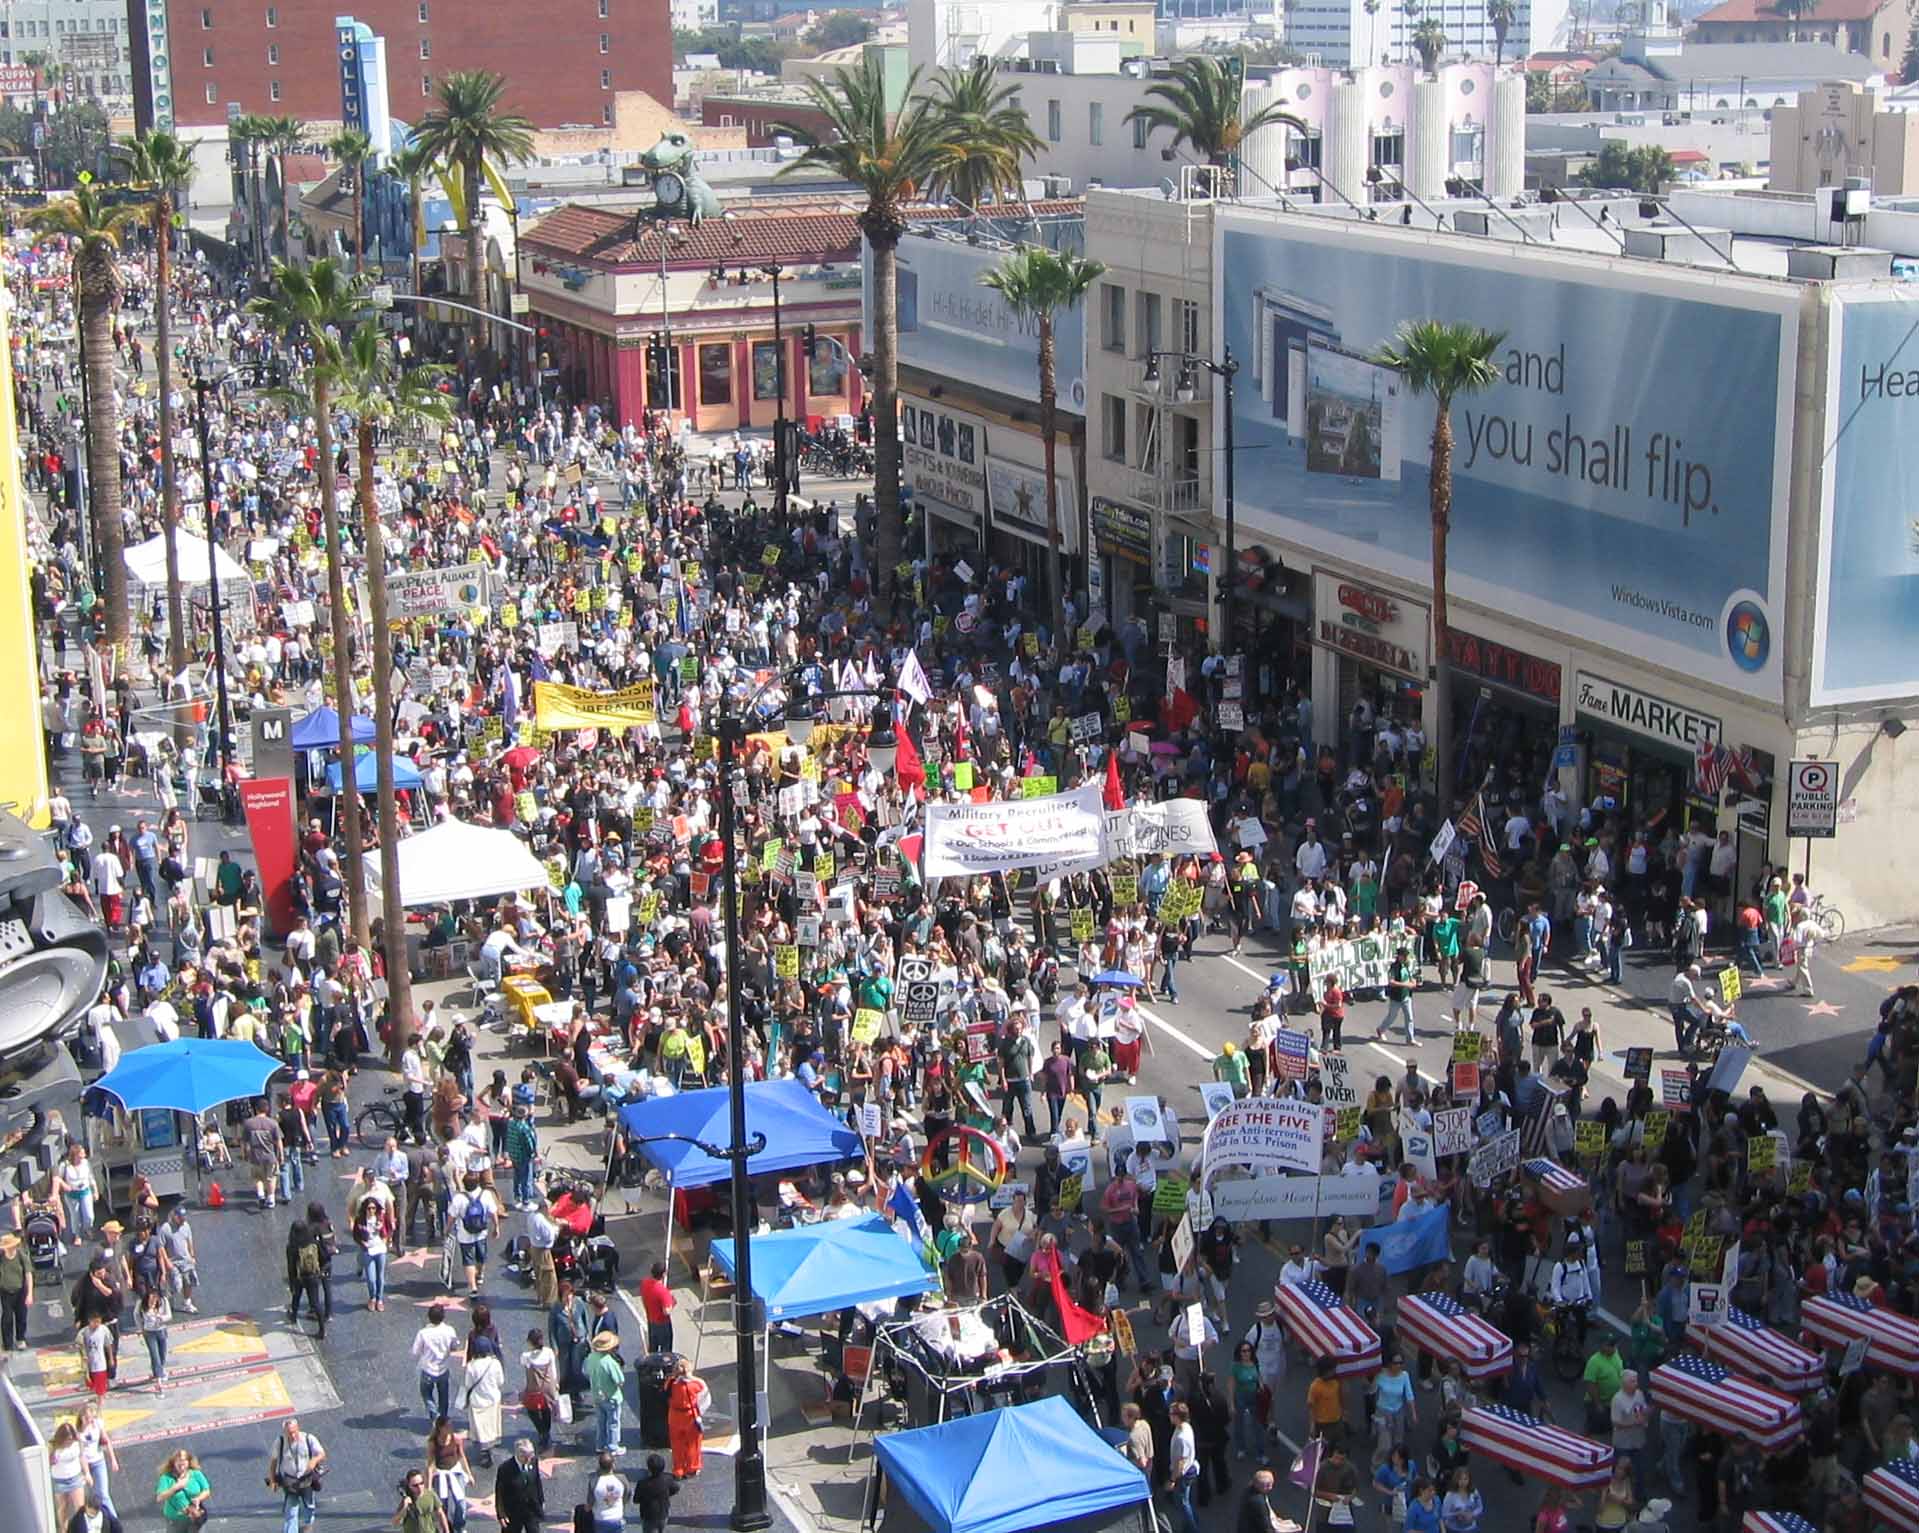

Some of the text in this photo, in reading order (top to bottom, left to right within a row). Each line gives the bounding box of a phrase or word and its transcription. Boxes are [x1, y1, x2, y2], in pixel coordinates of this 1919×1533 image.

[1506, 344, 1564, 394] and
[1464, 410, 1719, 527] you shall flip.
[1611, 584, 1713, 630] WindowsVista.com
[1579, 683, 1717, 745] Fame MARKET
[264, 720, 283, 739] M
[1795, 792, 1830, 801] PUBLIC
[949, 807, 1000, 821] Military
[1791, 801, 1833, 811] PARKING
[965, 823, 1008, 838] GET
[908, 1000, 935, 1009] WAR
[1323, 1056, 1349, 1074] WAR
[1332, 1073, 1343, 1088] IS
[1324, 1086, 1356, 1103] OVER!
[1256, 1100, 1295, 1111] Against
[1245, 1112, 1273, 1125] THE
[1278, 1114, 1310, 1131] FIVE
[1436, 1110, 1468, 1134] STOP
[1240, 1126, 1311, 1143] Anti-terrorists
[1242, 1135, 1262, 1145] U.S.
[1265, 1137, 1298, 1151] Prison
[1437, 1133, 1468, 1153] WAR
